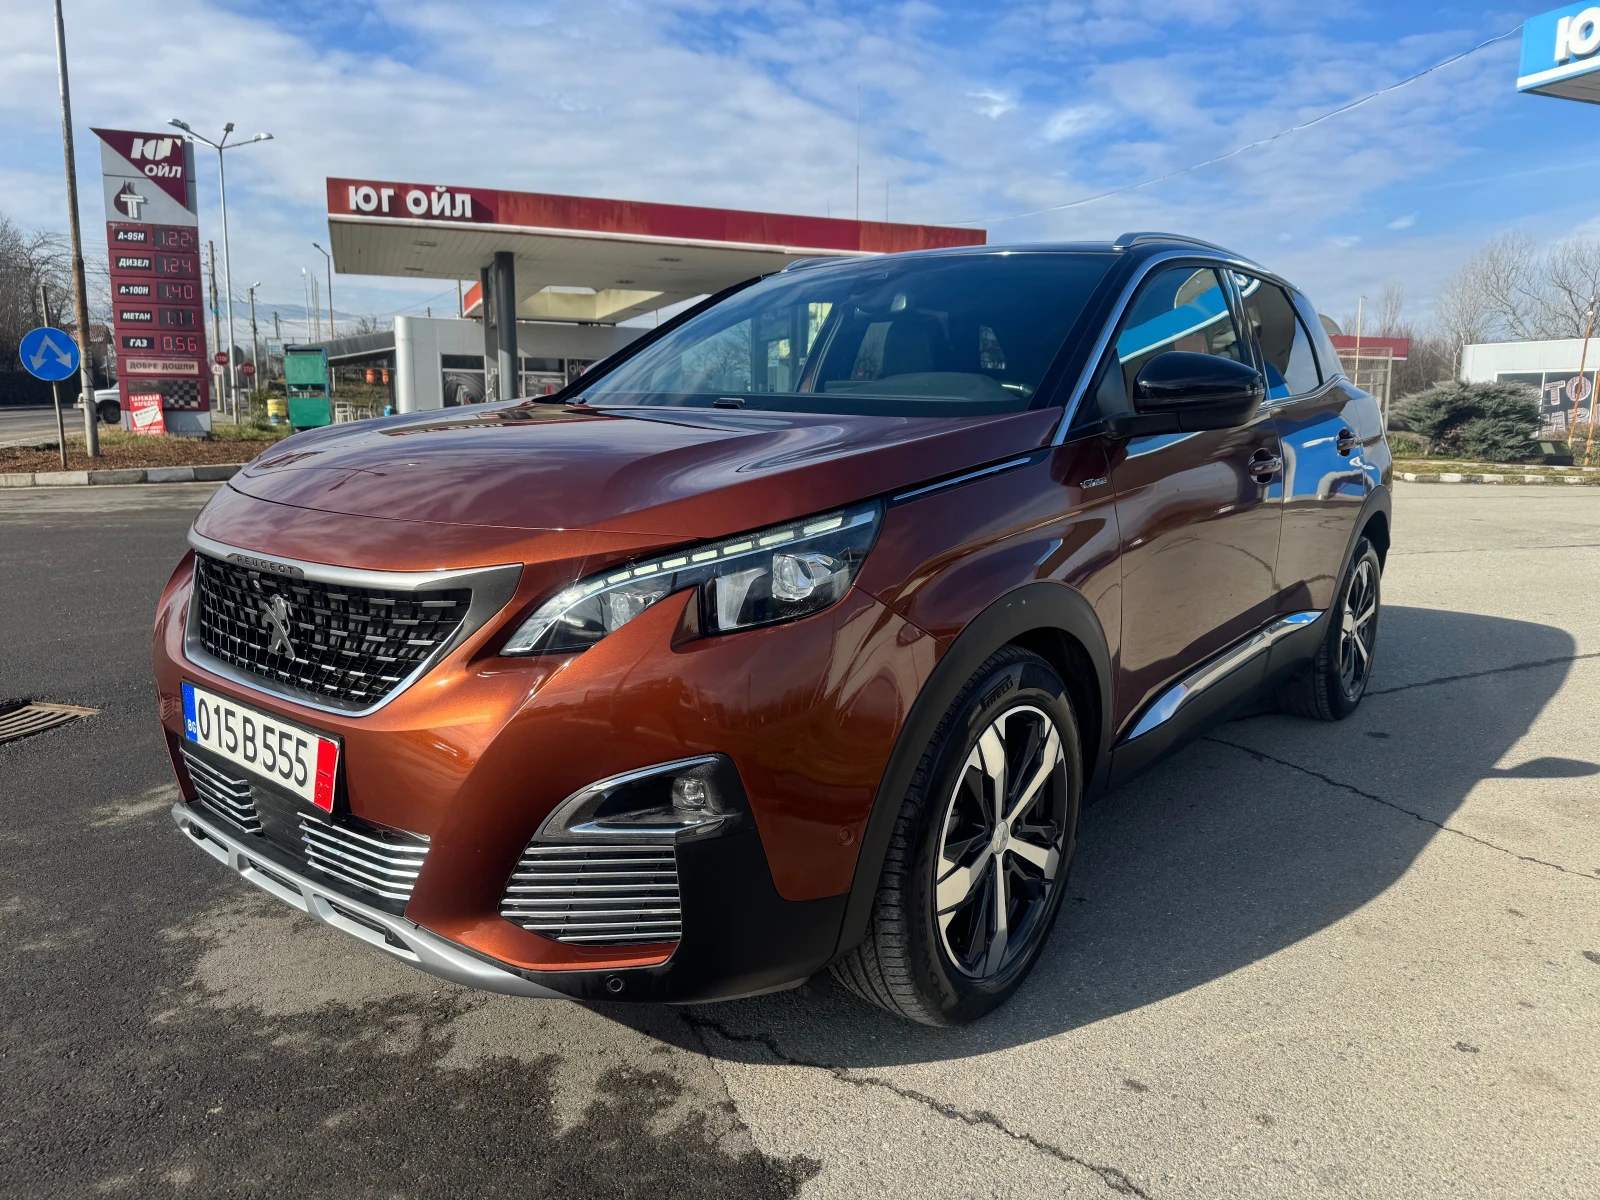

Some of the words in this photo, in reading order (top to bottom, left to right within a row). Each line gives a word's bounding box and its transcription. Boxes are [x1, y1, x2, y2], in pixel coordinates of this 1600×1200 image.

[144, 163, 182, 178] ОЙЛ
[348, 185, 395, 213] ЮГ
[405, 185, 473, 218] ОЙЛ
[117, 231, 145, 242] А-95Н
[161, 231, 190, 247] 1.22
[118, 257, 150, 268] ДИЗЕЛ
[162, 258, 192, 273] 1.24
[120, 285, 149, 295] А-100Н
[165, 284, 193, 300] 1.40
[122, 311, 151, 321] МЕТАН
[167, 311, 195, 325] 1.11
[129, 338, 148, 348] ГАЗ
[163, 336, 197, 352] 0.56
[129, 362, 158, 371] ДОБРЕ
[161, 362, 195, 371] ДОШЛИ
[570, 361, 586, 375] glo
[237, 555, 294, 574] PEUGEOT
[979, 674, 1014, 713] PIRELLI
[187, 718, 197, 733] BG
